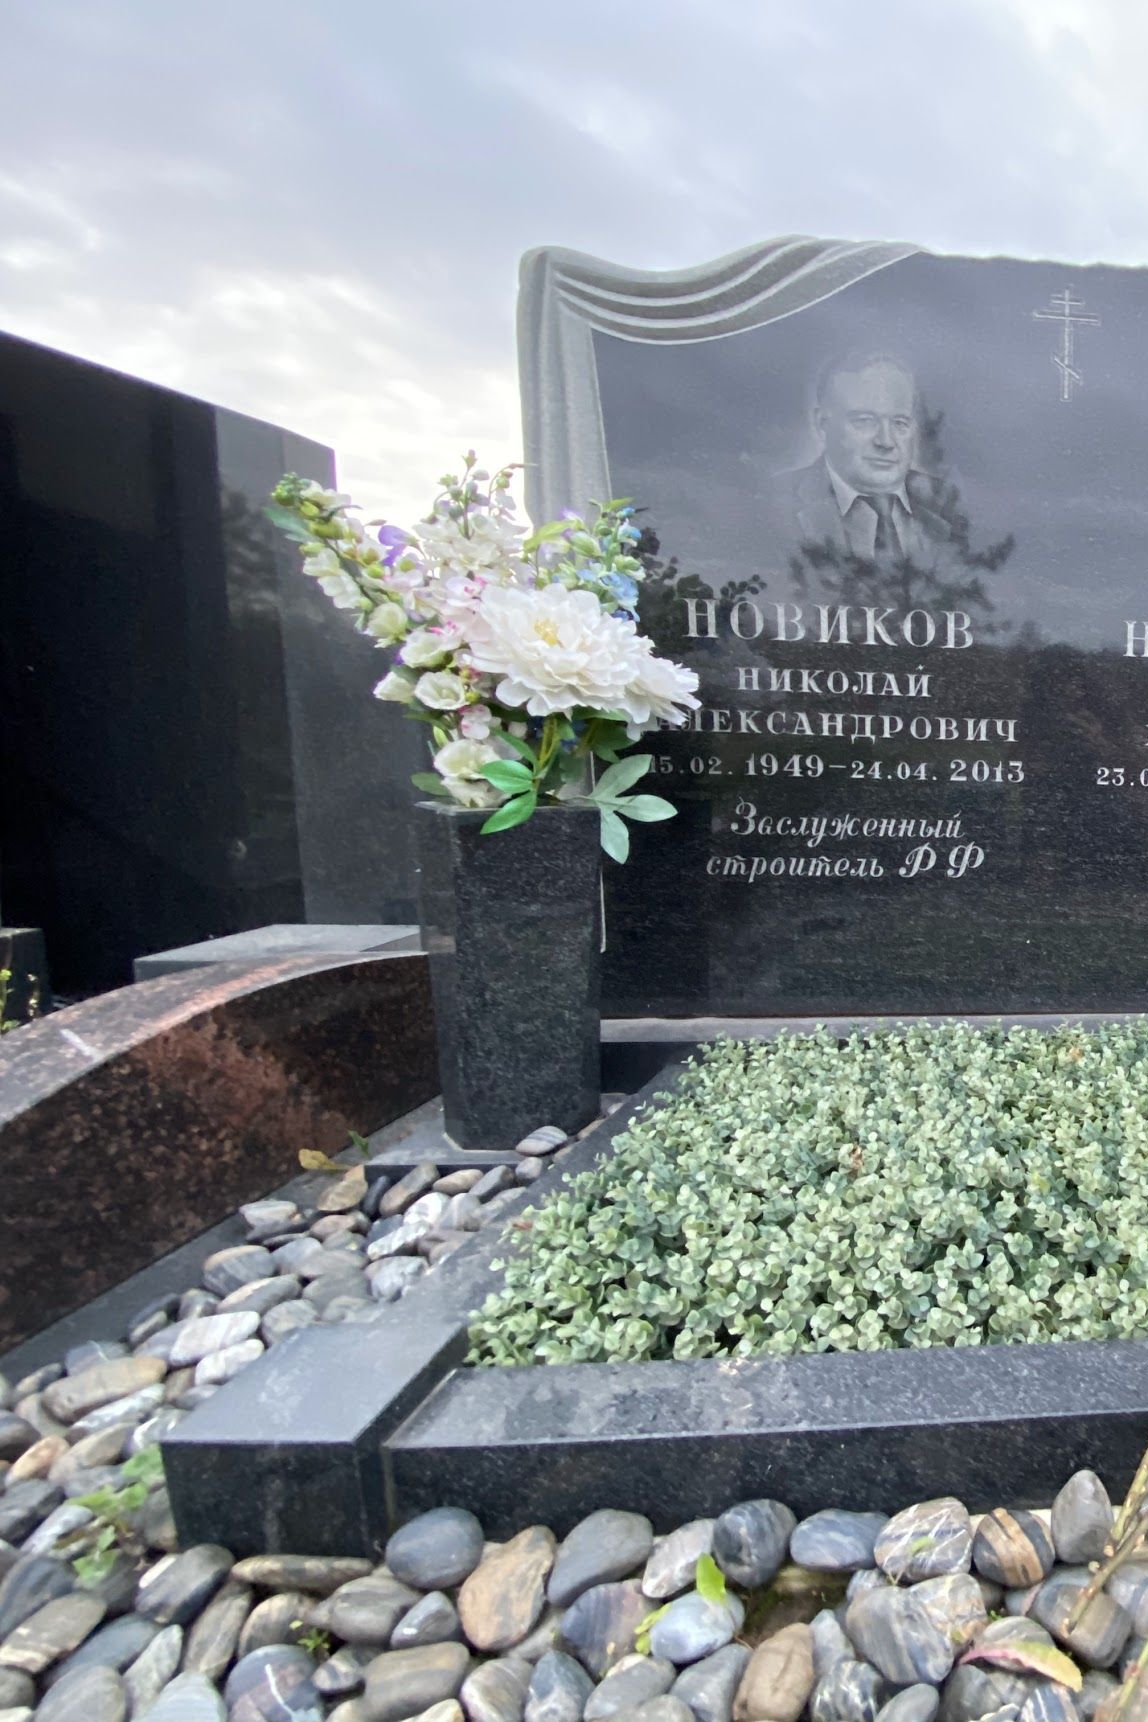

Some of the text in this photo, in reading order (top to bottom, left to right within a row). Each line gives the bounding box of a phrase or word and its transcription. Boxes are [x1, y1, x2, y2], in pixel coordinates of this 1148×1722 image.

[683, 597, 975, 650] НОВИКОВ
[735, 664, 933, 699] НИКОЛАЙ
[729, 796, 966, 848] Заслуженный
[706, 847, 885, 884] строитель
